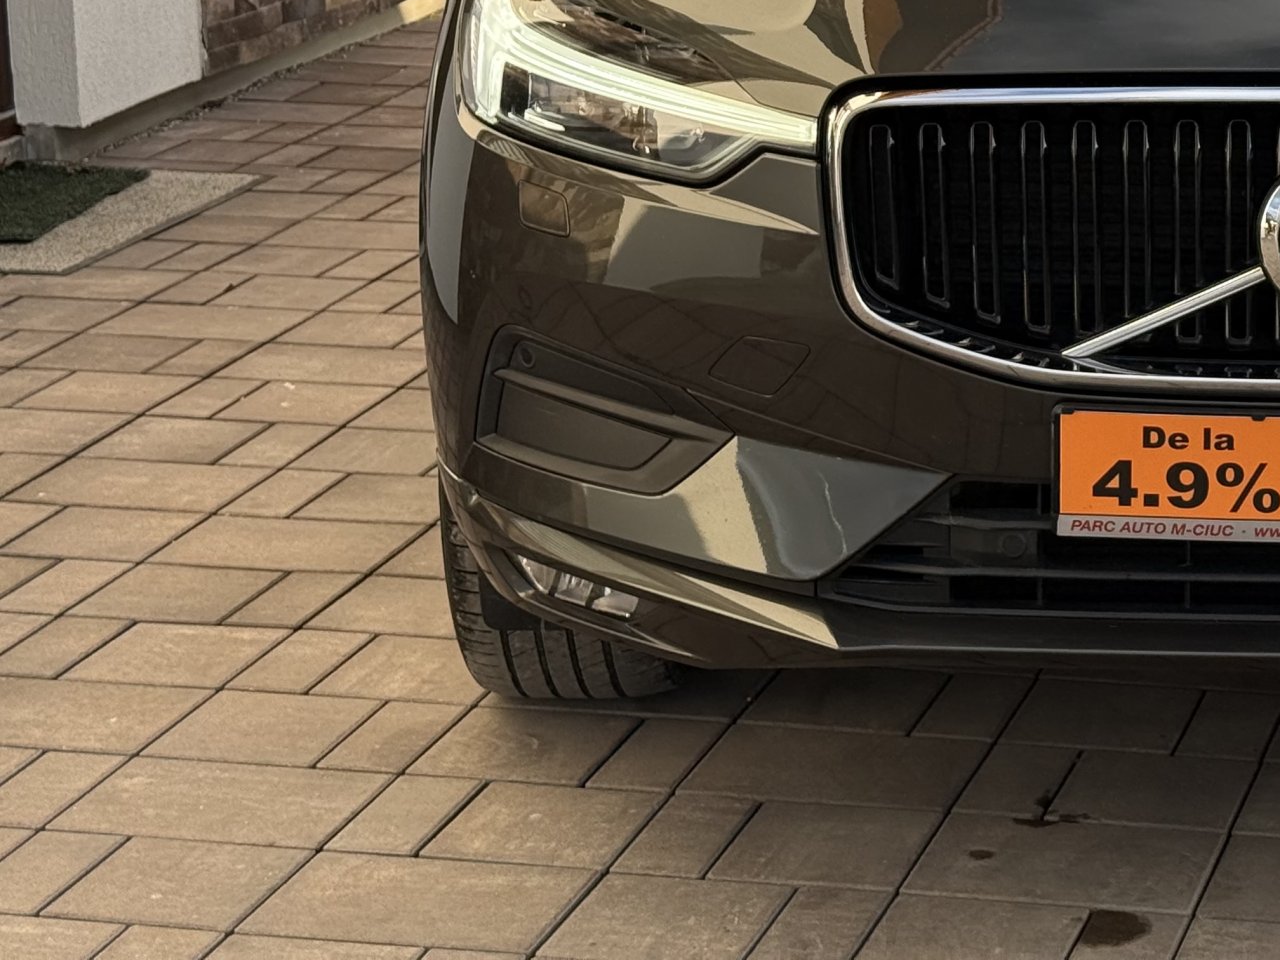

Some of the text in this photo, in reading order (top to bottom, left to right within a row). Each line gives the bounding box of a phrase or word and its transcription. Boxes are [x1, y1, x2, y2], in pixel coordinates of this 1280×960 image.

[1141, 426, 1235, 451] De la
[1070, 519, 1116, 533] PARC
[1118, 521, 1167, 535] AUTO
[1170, 523, 1234, 537] M-CIUC
